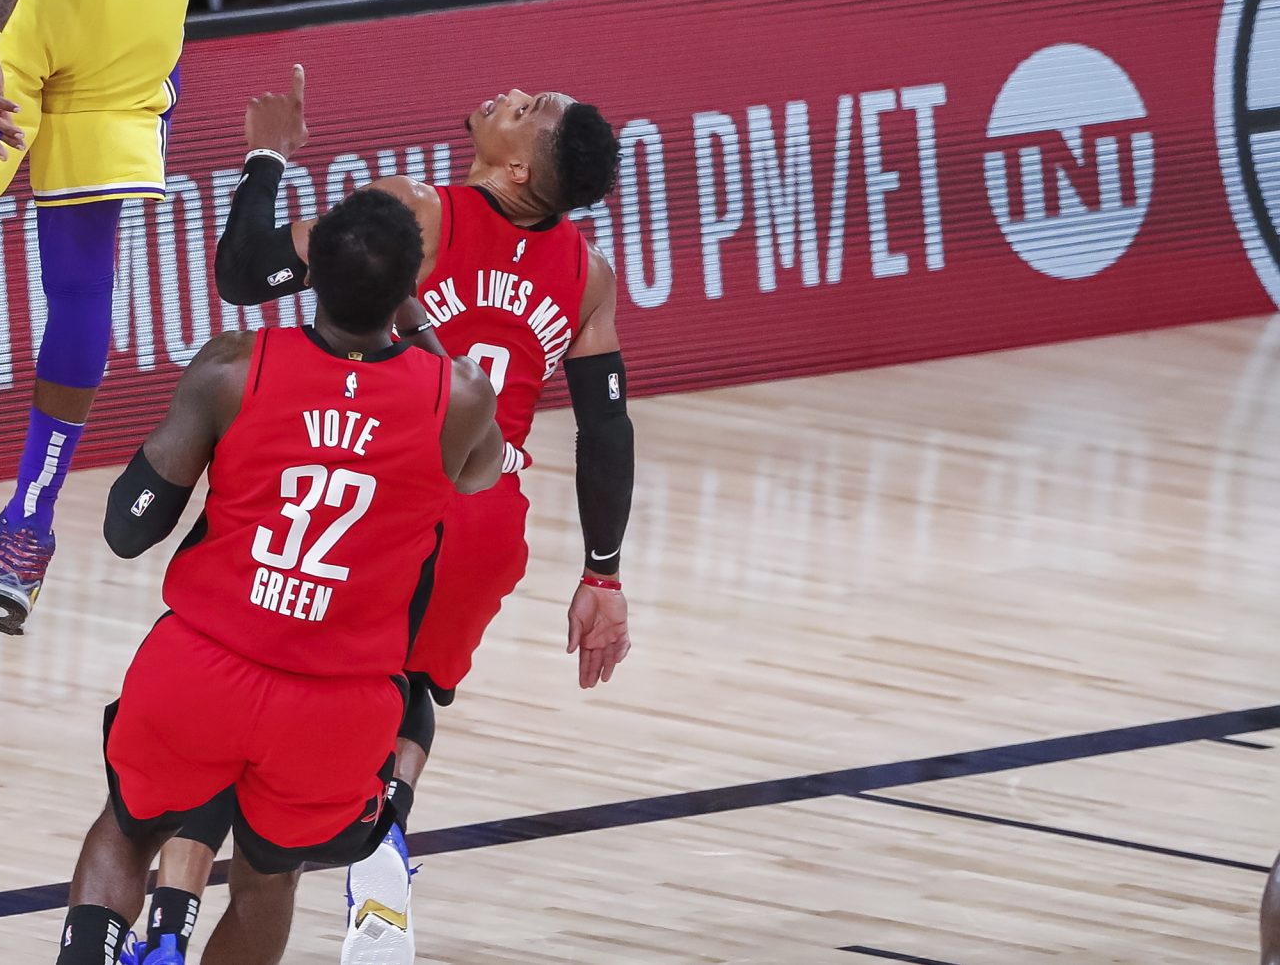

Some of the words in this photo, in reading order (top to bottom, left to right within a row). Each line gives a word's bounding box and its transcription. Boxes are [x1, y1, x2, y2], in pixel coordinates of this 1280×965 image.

[692, 82, 948, 301] PM/ET
[476, 269, 534, 316] LIVES
[302, 409, 380, 456] VOTE
[251, 464, 377, 581] 32
[250, 567, 332, 621] GREEN
